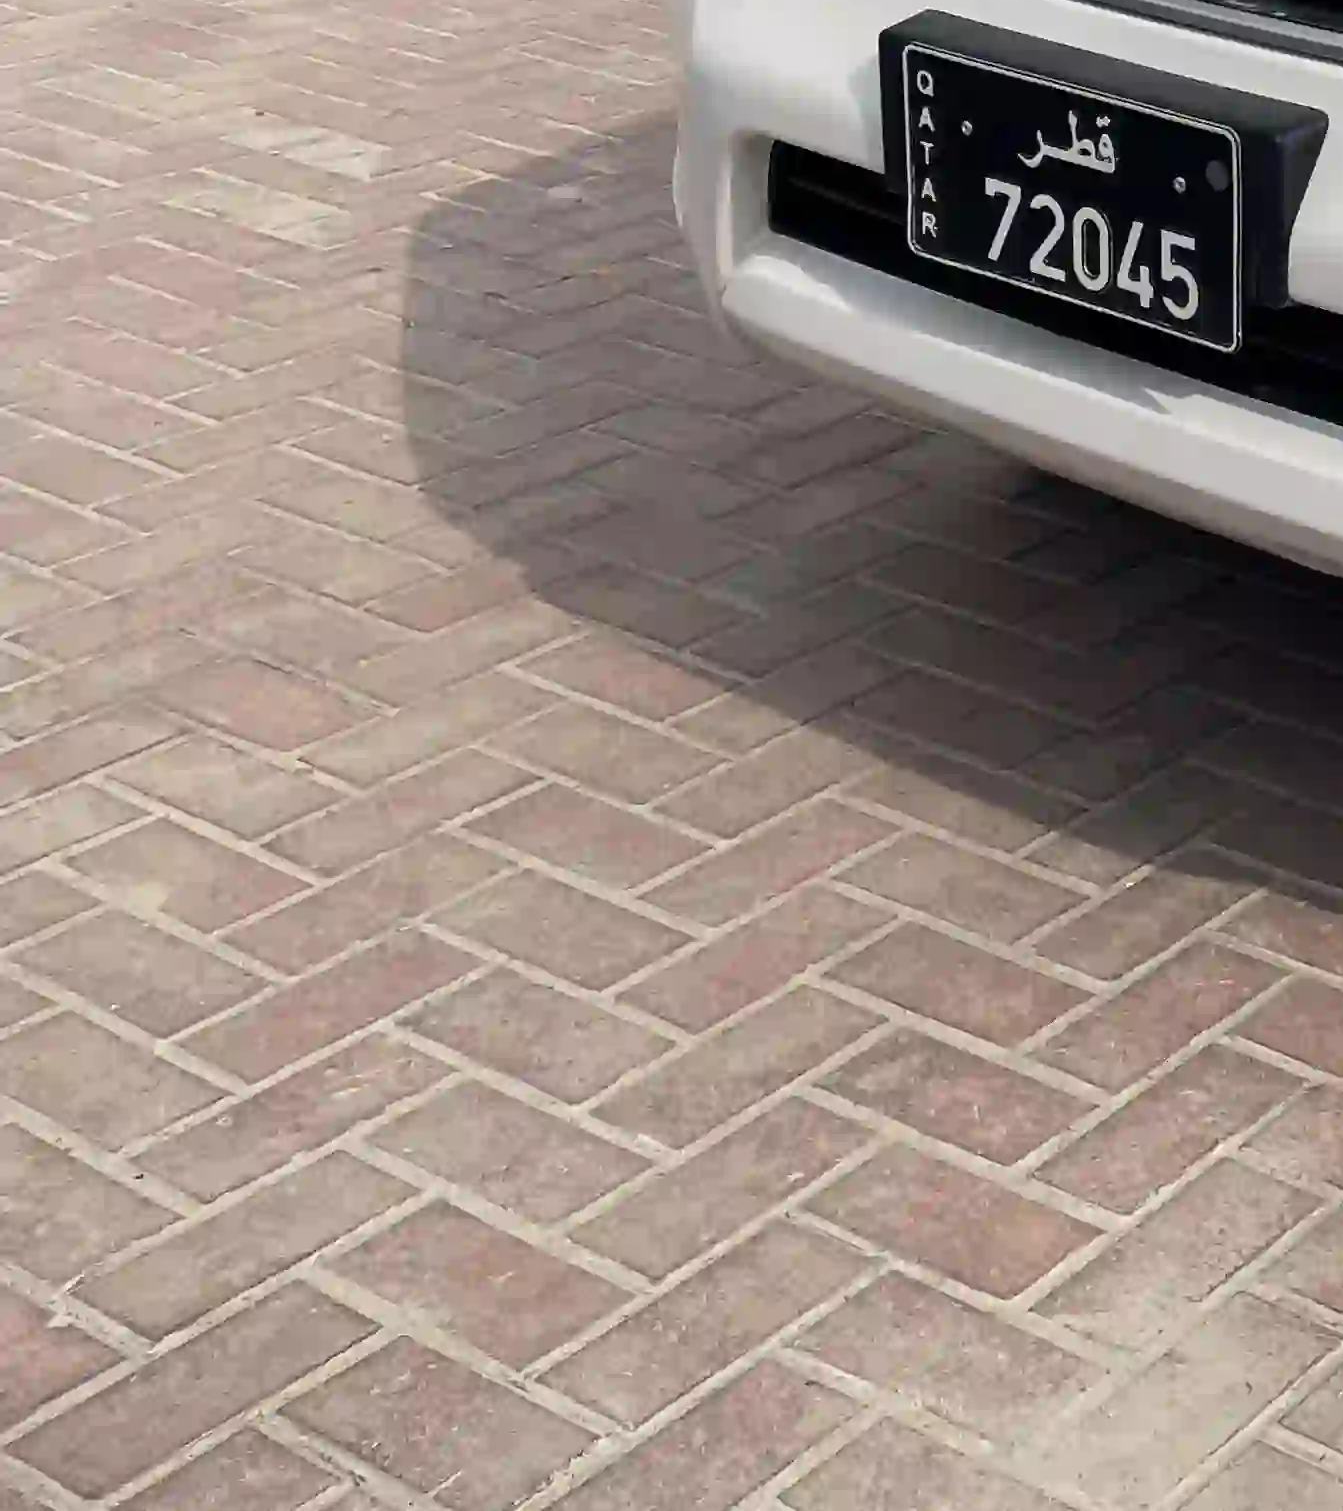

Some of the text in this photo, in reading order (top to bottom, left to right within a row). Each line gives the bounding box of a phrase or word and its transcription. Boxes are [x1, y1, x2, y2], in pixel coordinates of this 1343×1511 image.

[916, 70, 938, 238] QATAR
[1018, 110, 1116, 173] قطر
[984, 177, 1199, 321] 72045
